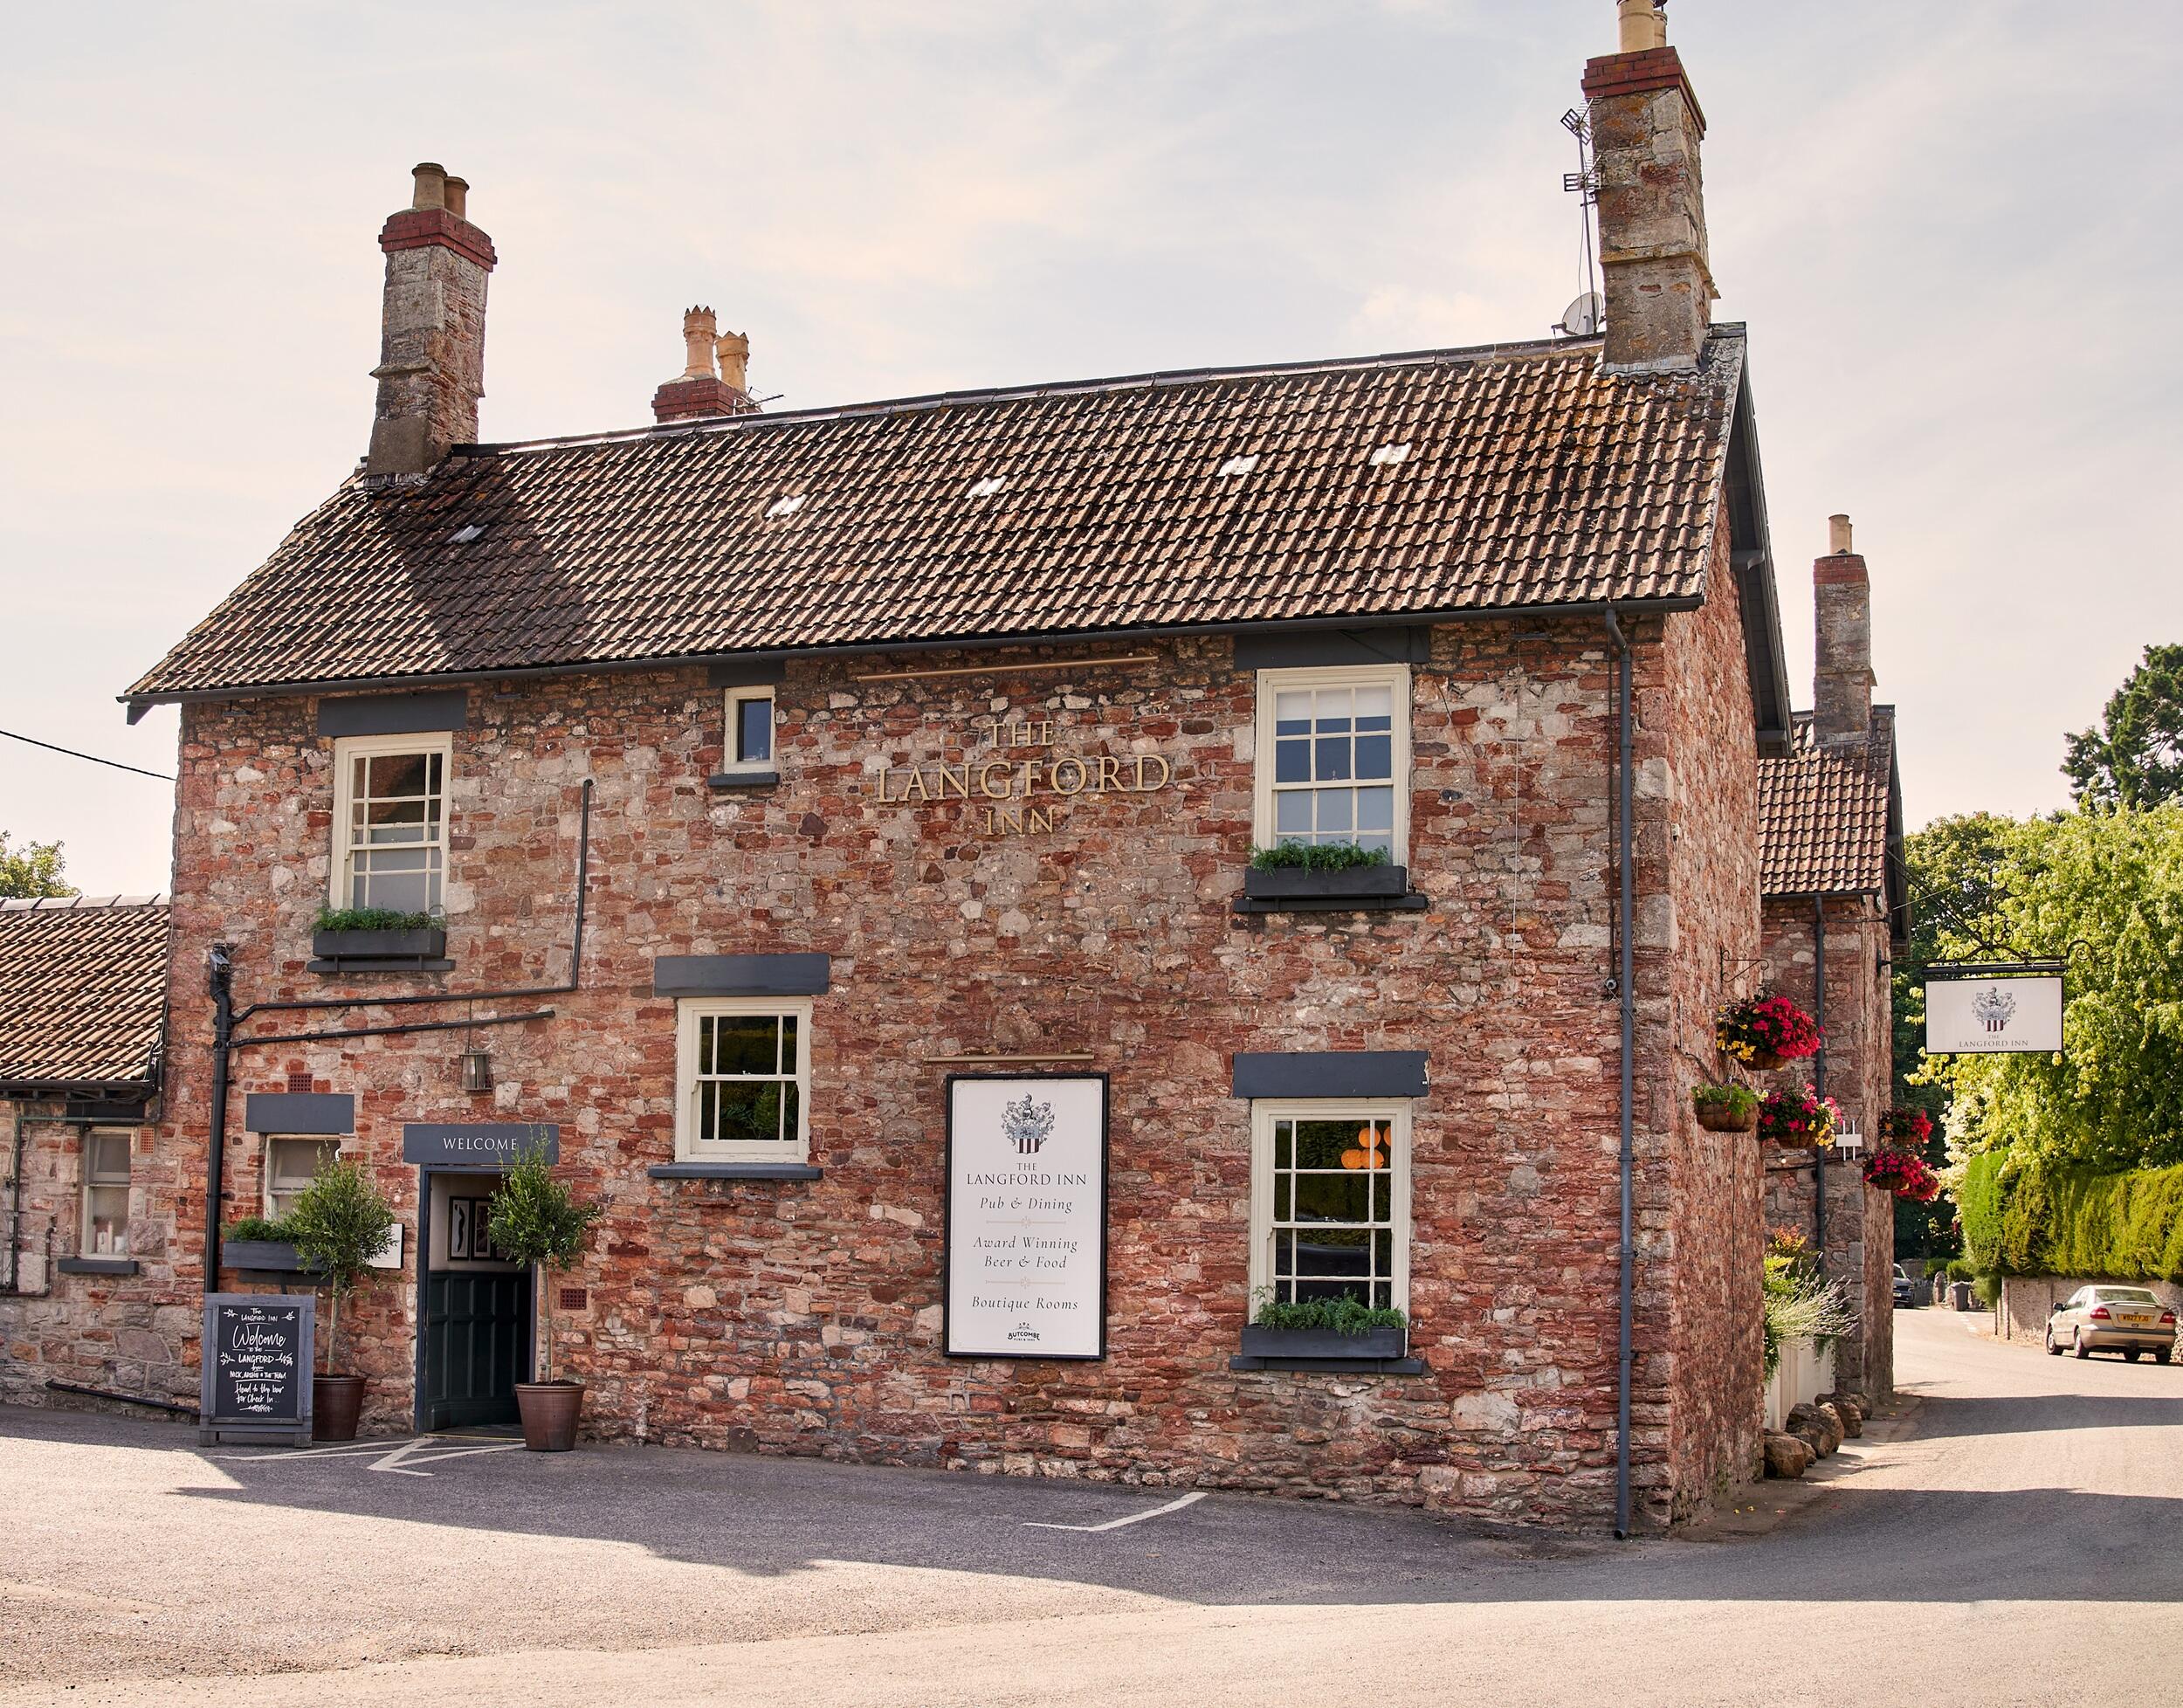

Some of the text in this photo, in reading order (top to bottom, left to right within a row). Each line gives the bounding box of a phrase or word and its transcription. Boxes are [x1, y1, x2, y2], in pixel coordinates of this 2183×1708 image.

[987, 720, 1054, 748] THE
[877, 754, 1171, 803] LANGFORD
[986, 809, 1053, 836] INN
[443, 1137, 518, 1151] WELCOME
[1016, 1162, 1037, 1171] THE
[967, 1174, 1087, 1185] LANGFORD INN
[980, 1196, 1073, 1214] Pub & Dining
[973, 1236, 1078, 1254] Award Winning
[984, 1256, 1067, 1269] Beer & Food
[972, 1296, 1078, 1312] Boutique Rooms
[232, 1325, 286, 1348] Welcome
[1007, 1331, 1040, 1341] BUTCOMBE
[238, 1353, 274, 1363] LANGFORD
